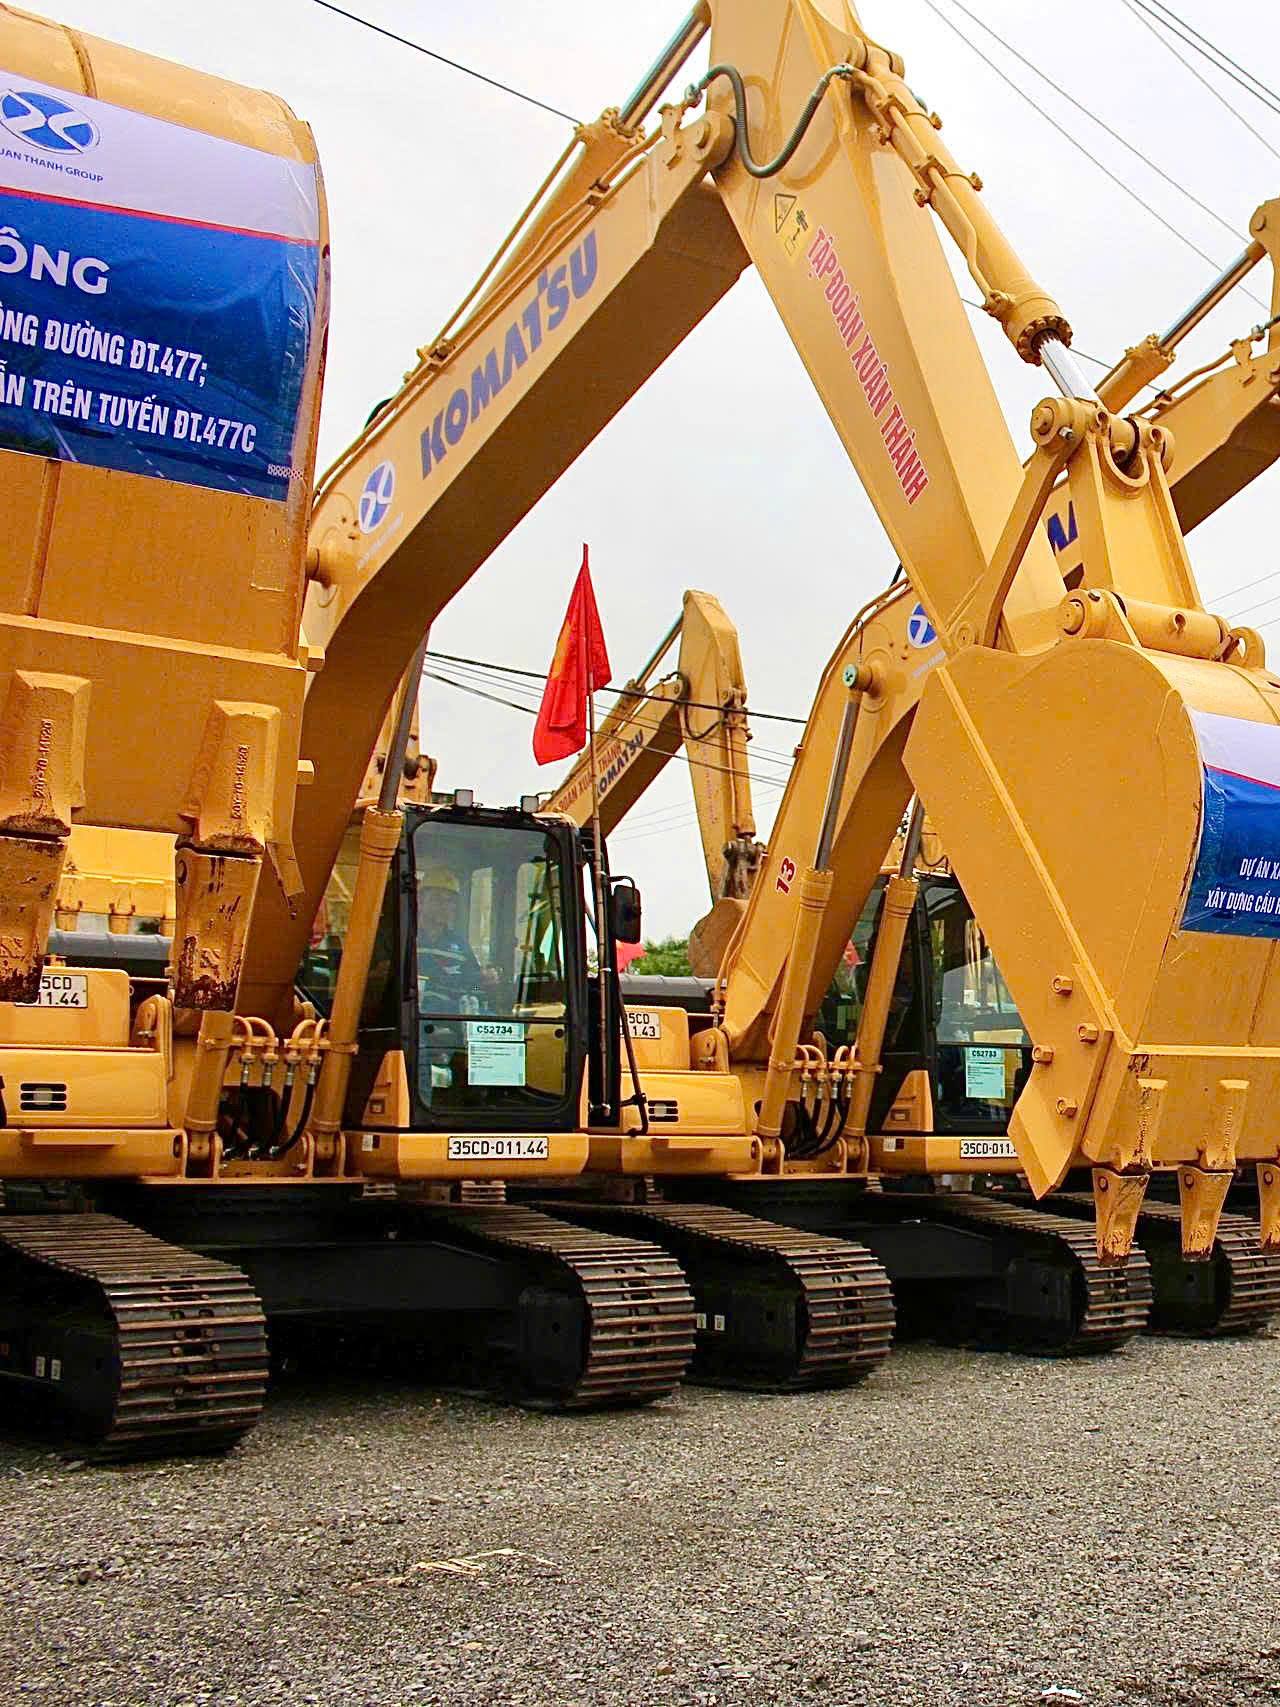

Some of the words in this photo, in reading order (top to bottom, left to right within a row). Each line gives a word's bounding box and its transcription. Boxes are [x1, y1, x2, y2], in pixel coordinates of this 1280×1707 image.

[24, 155, 63, 172] THANH
[65, 167, 104, 183] GROUP
[0, 303, 39, 346] NG
[44, 319, 124, 366] ĐƯỜNG
[130, 338, 208, 387] ĐT.477;
[420, 229, 598, 480] KOMATSU
[807, 227, 837, 280] TẬP
[825, 268, 864, 348] ĐOÀN
[852, 332, 894, 418] XUÂN
[880, 403, 929, 504] THÀNH
[33, 379, 93, 420] TRÊN
[98, 394, 170, 436] TUYẾN
[174, 409, 257, 453] ĐT.477C
[598, 728, 644, 799] OMATSU
[776, 857, 796, 895] 13
[1254, 857, 1271, 878] ÁN
[42, 976, 72, 990] 5CD
[476, 1025, 513, 1034] C52734
